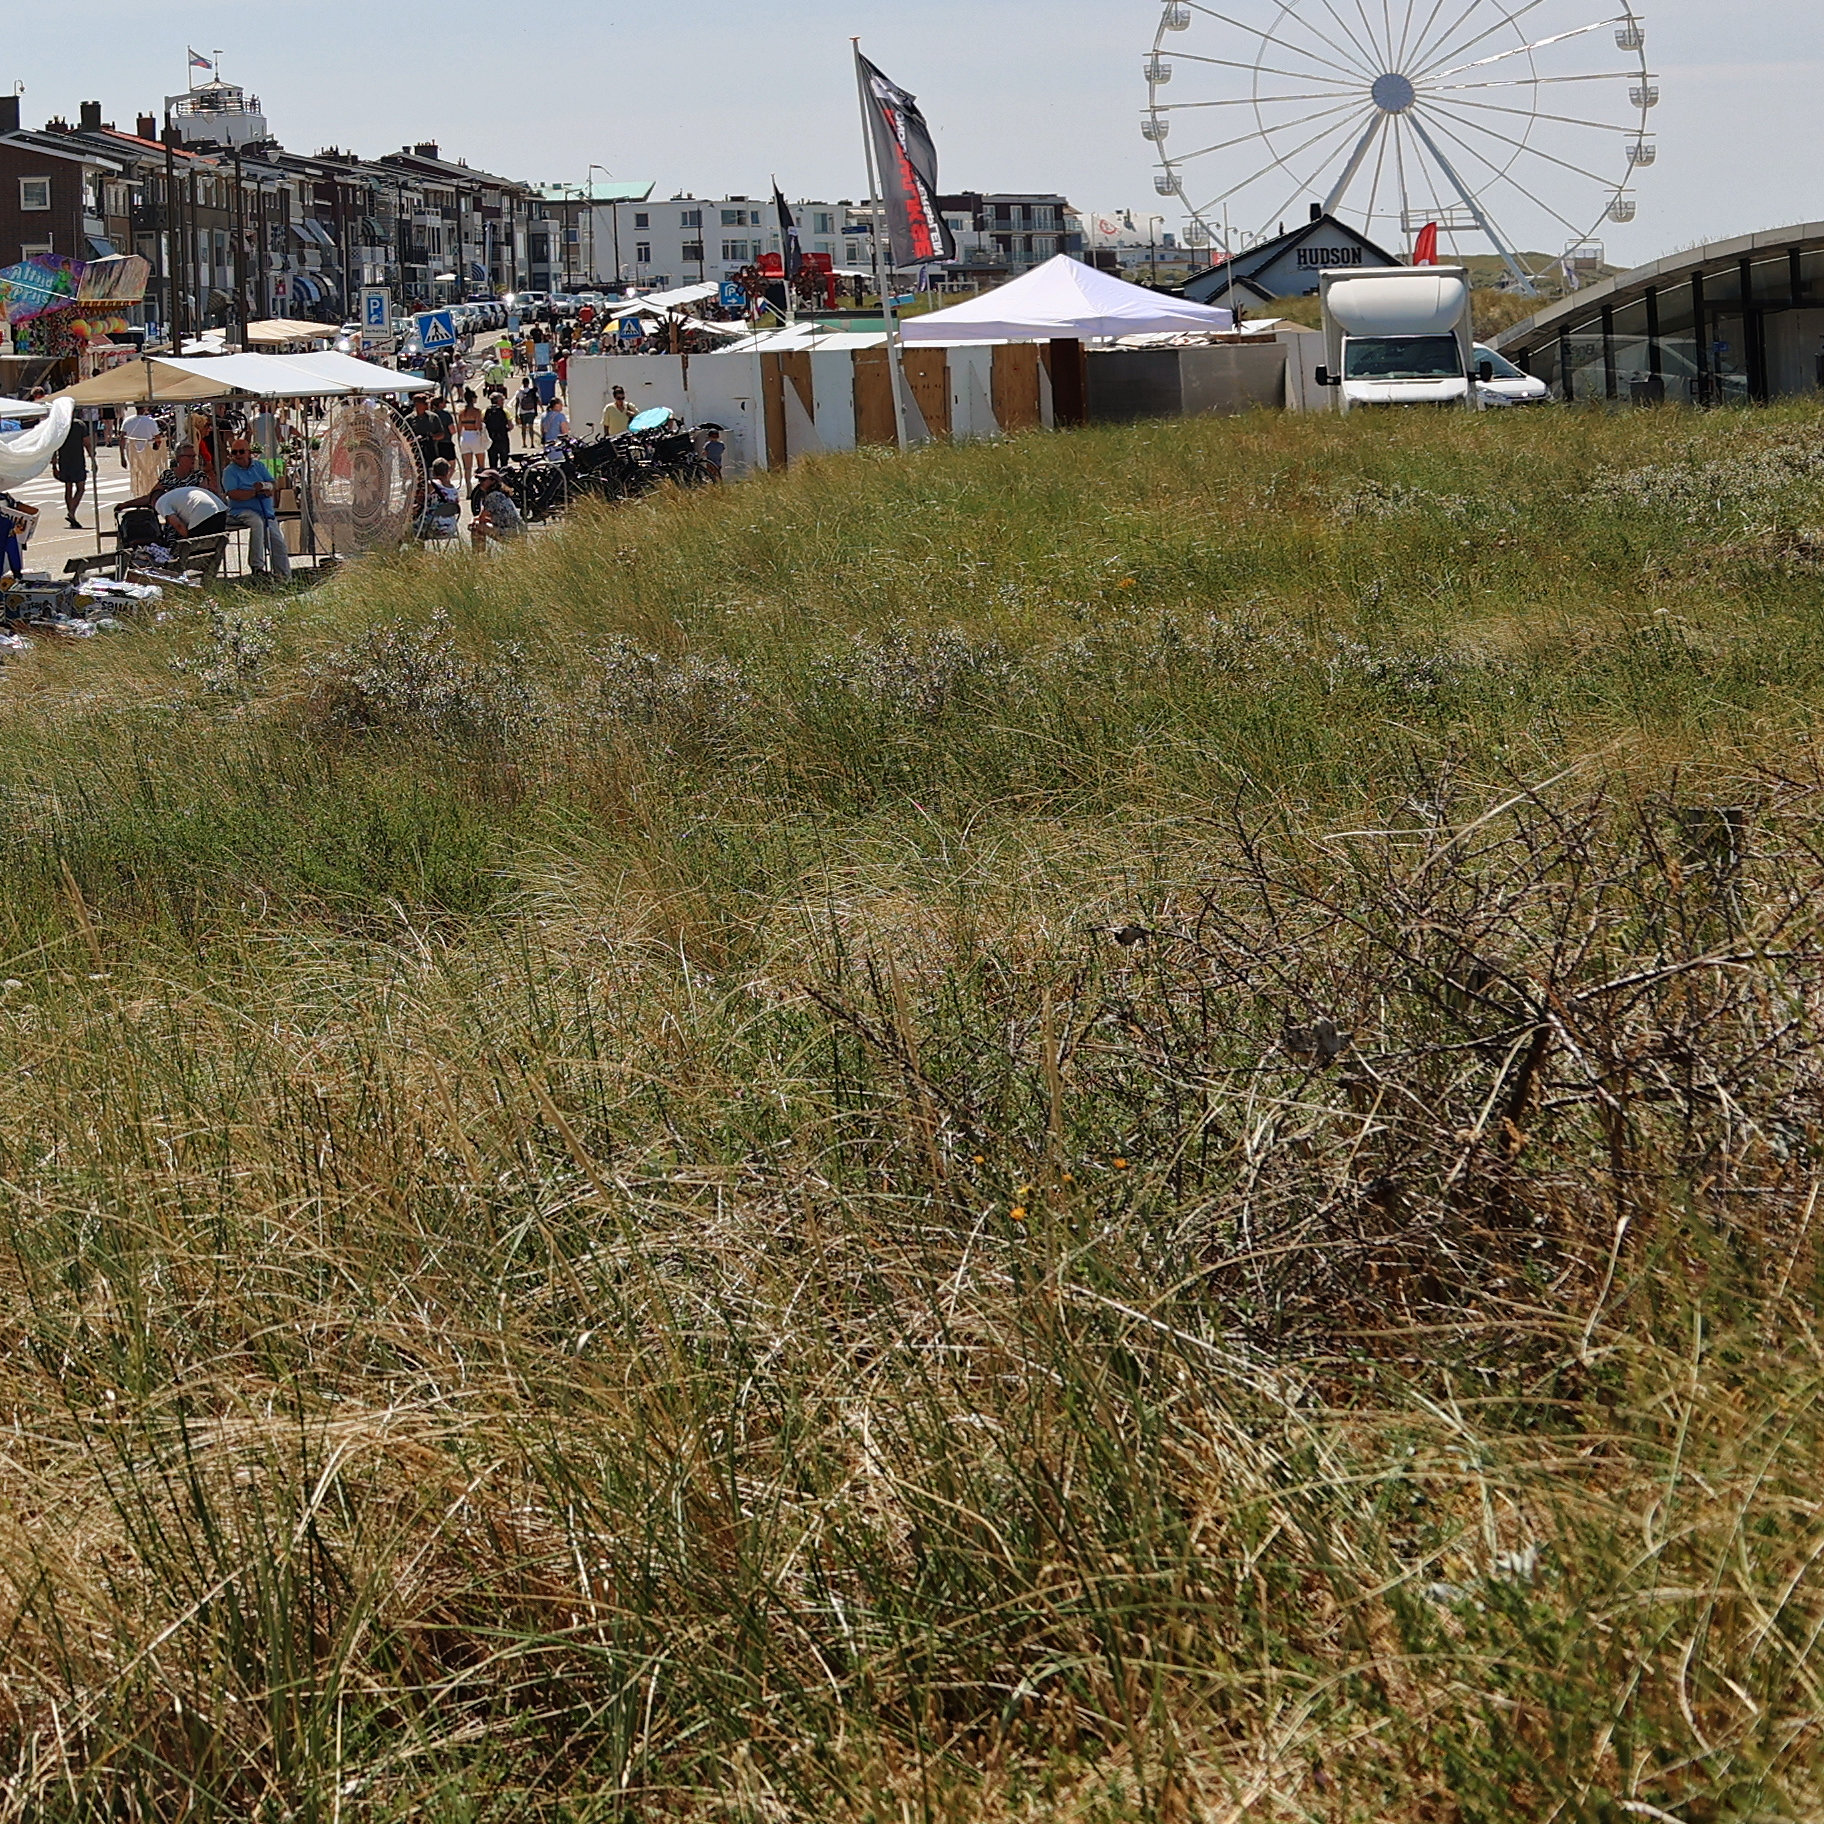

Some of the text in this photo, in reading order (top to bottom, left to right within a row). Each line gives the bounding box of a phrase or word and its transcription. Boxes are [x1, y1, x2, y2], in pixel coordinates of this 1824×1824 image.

[1297, 247, 1362, 265] HUDSON
[10, 265, 54, 288] Altijd
[10, 285, 49, 305] Prijs
[370, 299, 380, 314] P
